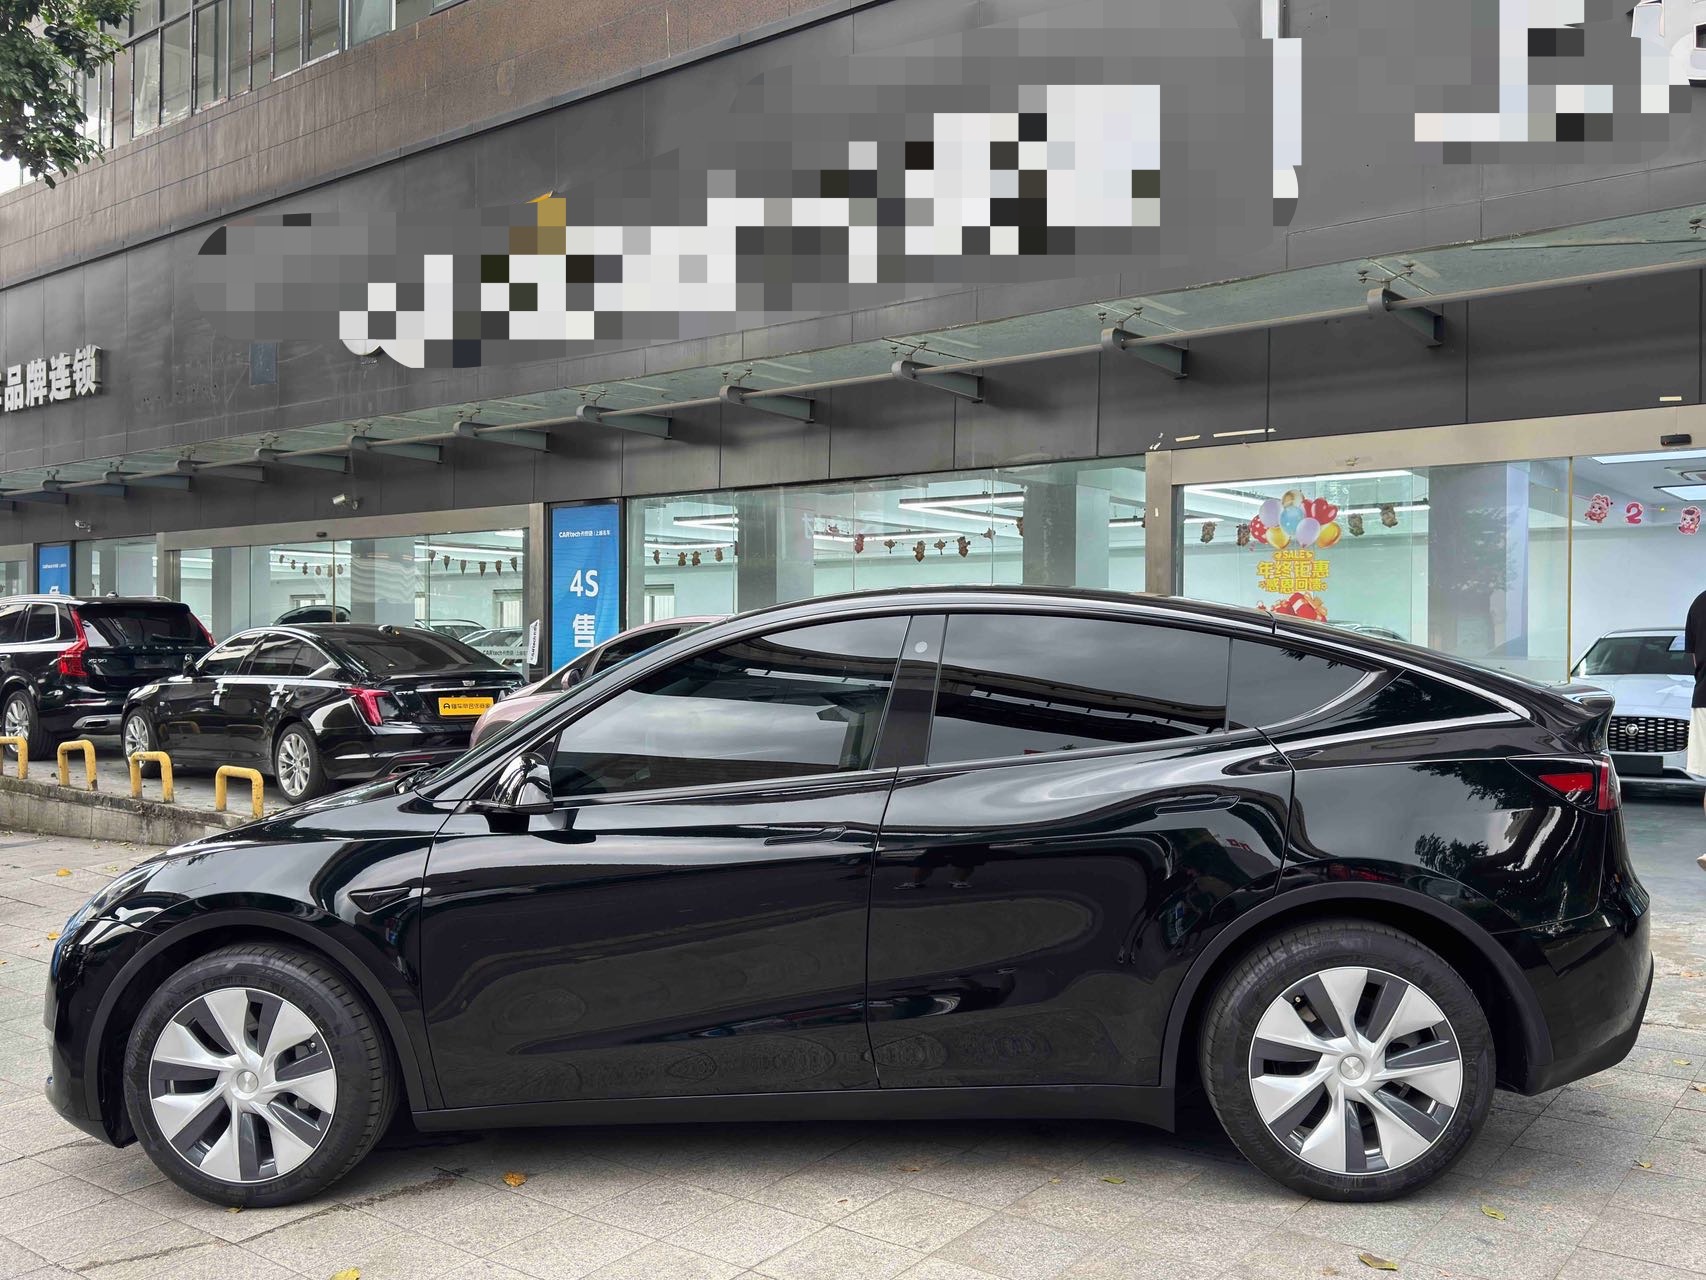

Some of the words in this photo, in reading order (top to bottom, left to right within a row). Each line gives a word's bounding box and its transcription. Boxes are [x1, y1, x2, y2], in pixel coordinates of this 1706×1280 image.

[0, 344, 98, 412] 品牌连锁
[1625, 501, 1643, 524] 2
[1283, 550, 1305, 560] SALE
[569, 569, 599, 597] 4S
[572, 613, 596, 648] 售
